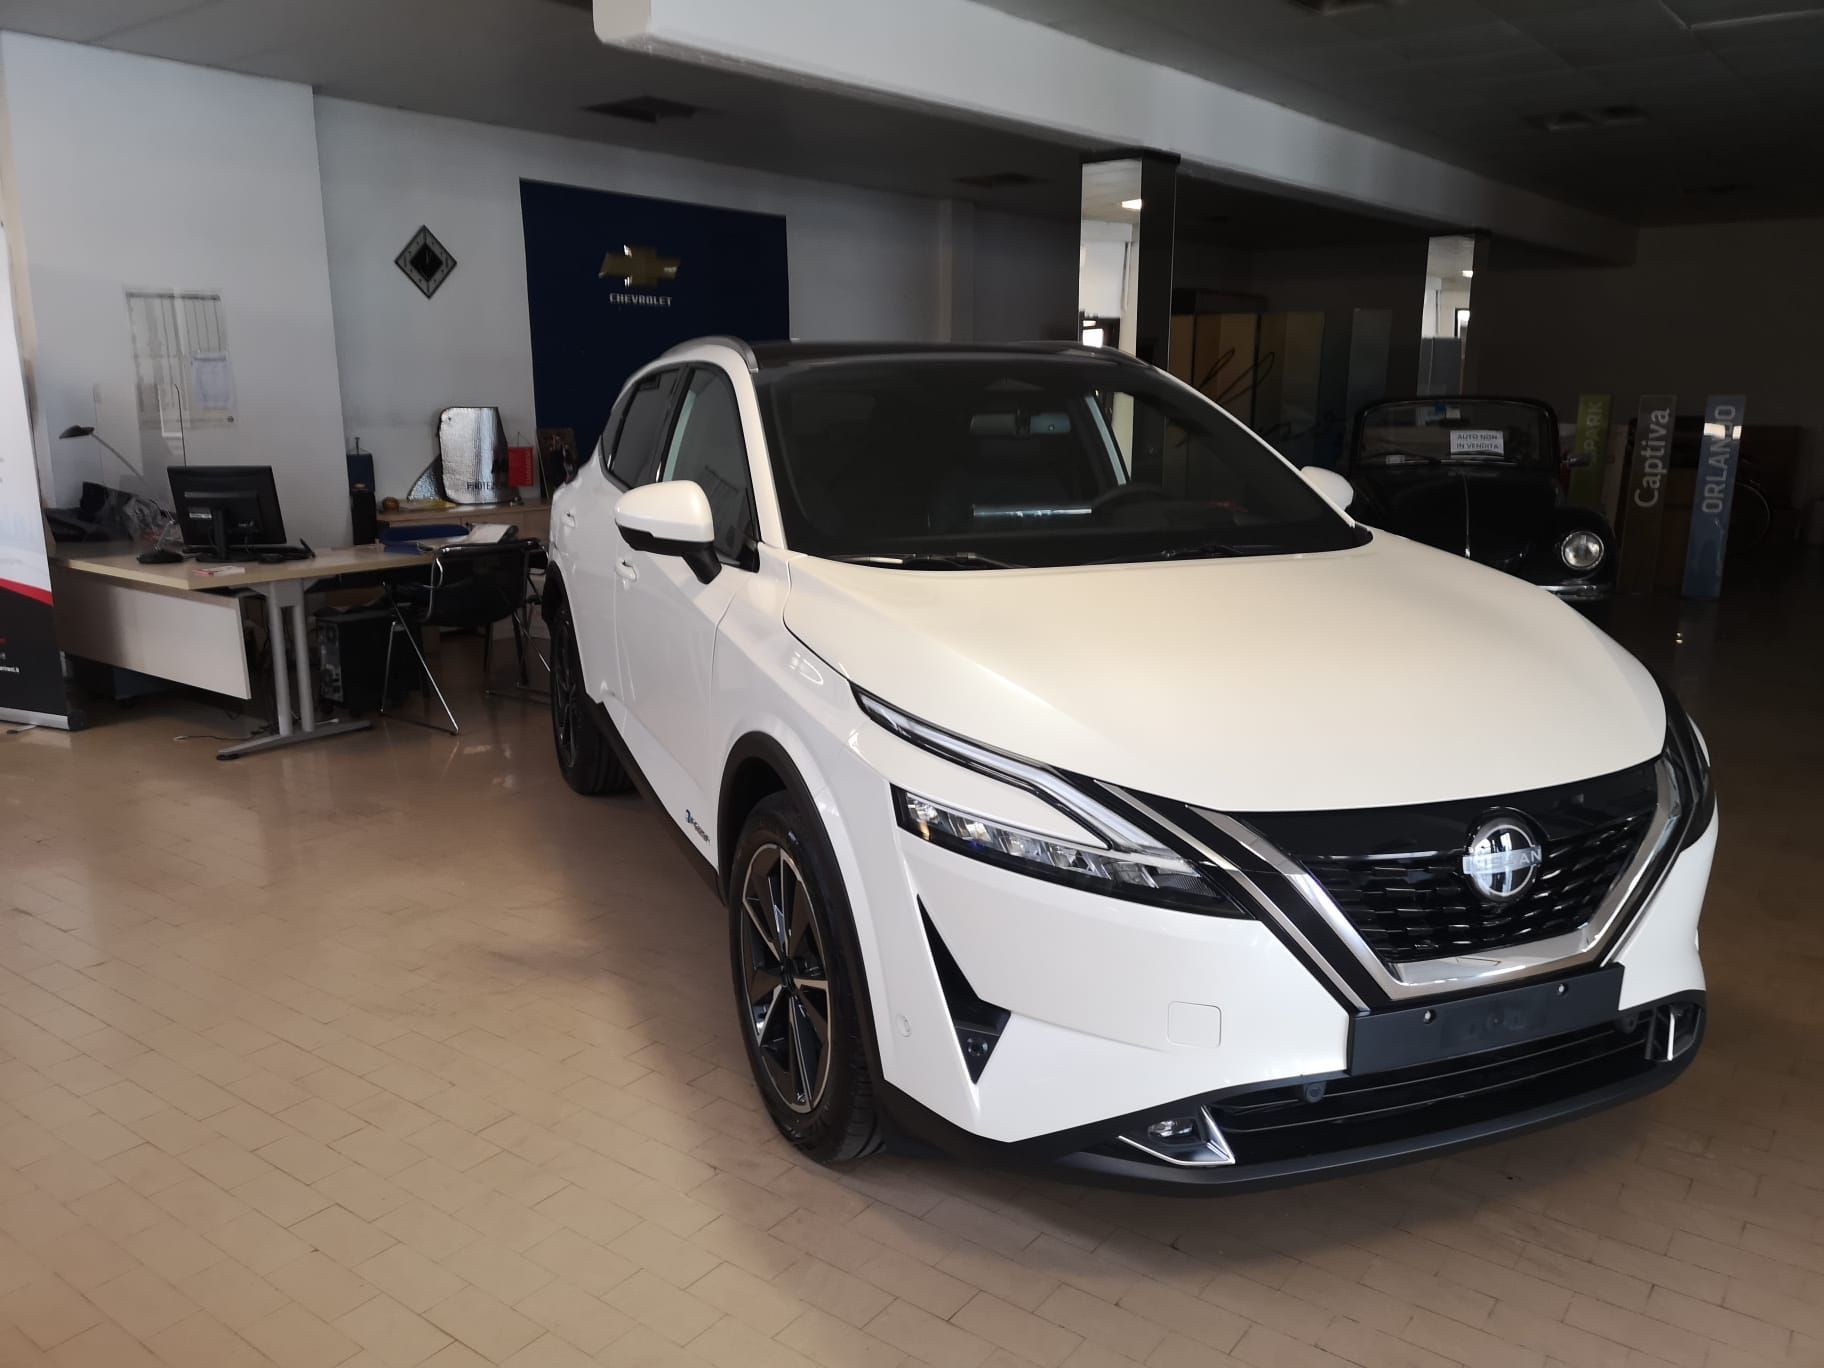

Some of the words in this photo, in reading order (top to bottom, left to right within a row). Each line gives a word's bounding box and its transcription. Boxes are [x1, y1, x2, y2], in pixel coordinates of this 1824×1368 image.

[609, 292, 672, 306] CHEVROLET
[1480, 433, 1498, 441] NON
[1634, 408, 1671, 507] Captiva
